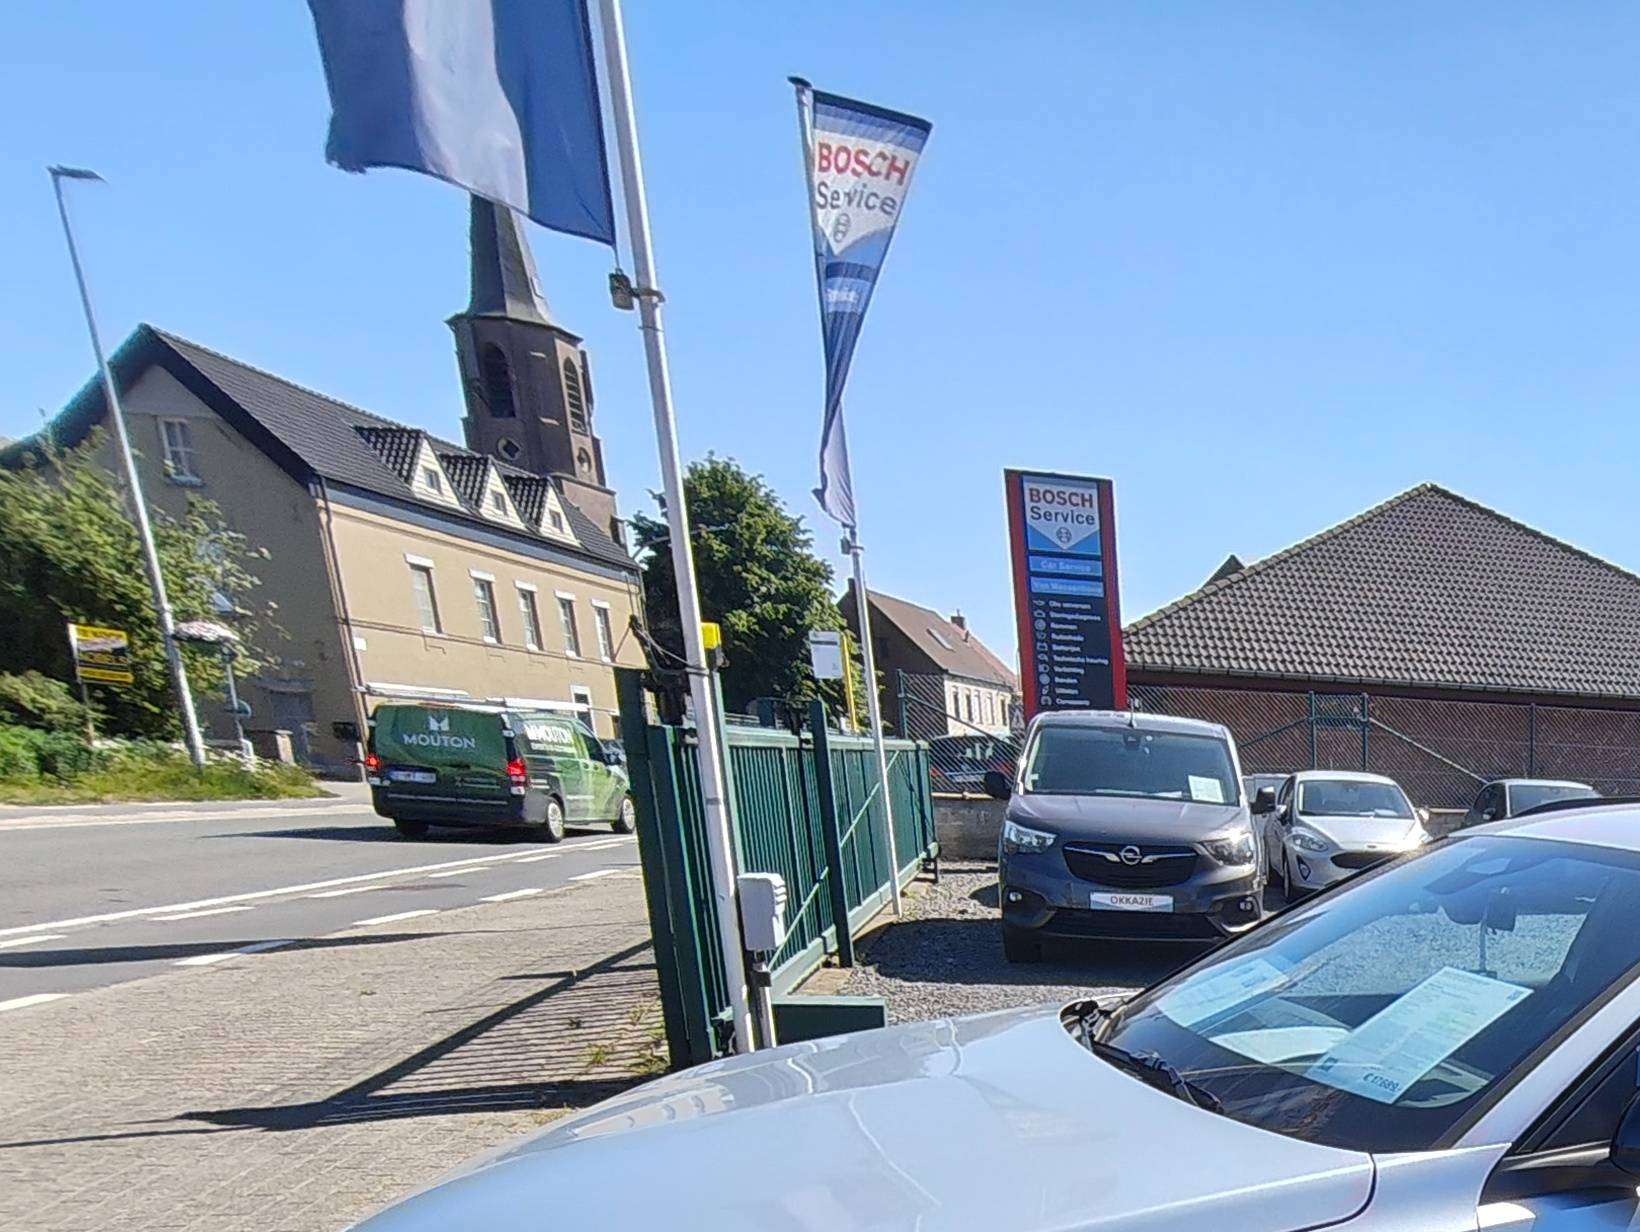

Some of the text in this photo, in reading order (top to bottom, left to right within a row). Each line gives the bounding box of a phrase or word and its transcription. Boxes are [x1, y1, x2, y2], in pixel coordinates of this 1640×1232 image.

[818, 142, 911, 187] BOSCH
[816, 181, 898, 216] Sevice
[1029, 487, 1094, 509] BOSCH
[1030, 506, 1096, 525] Service
[403, 733, 476, 748] MOUTON
